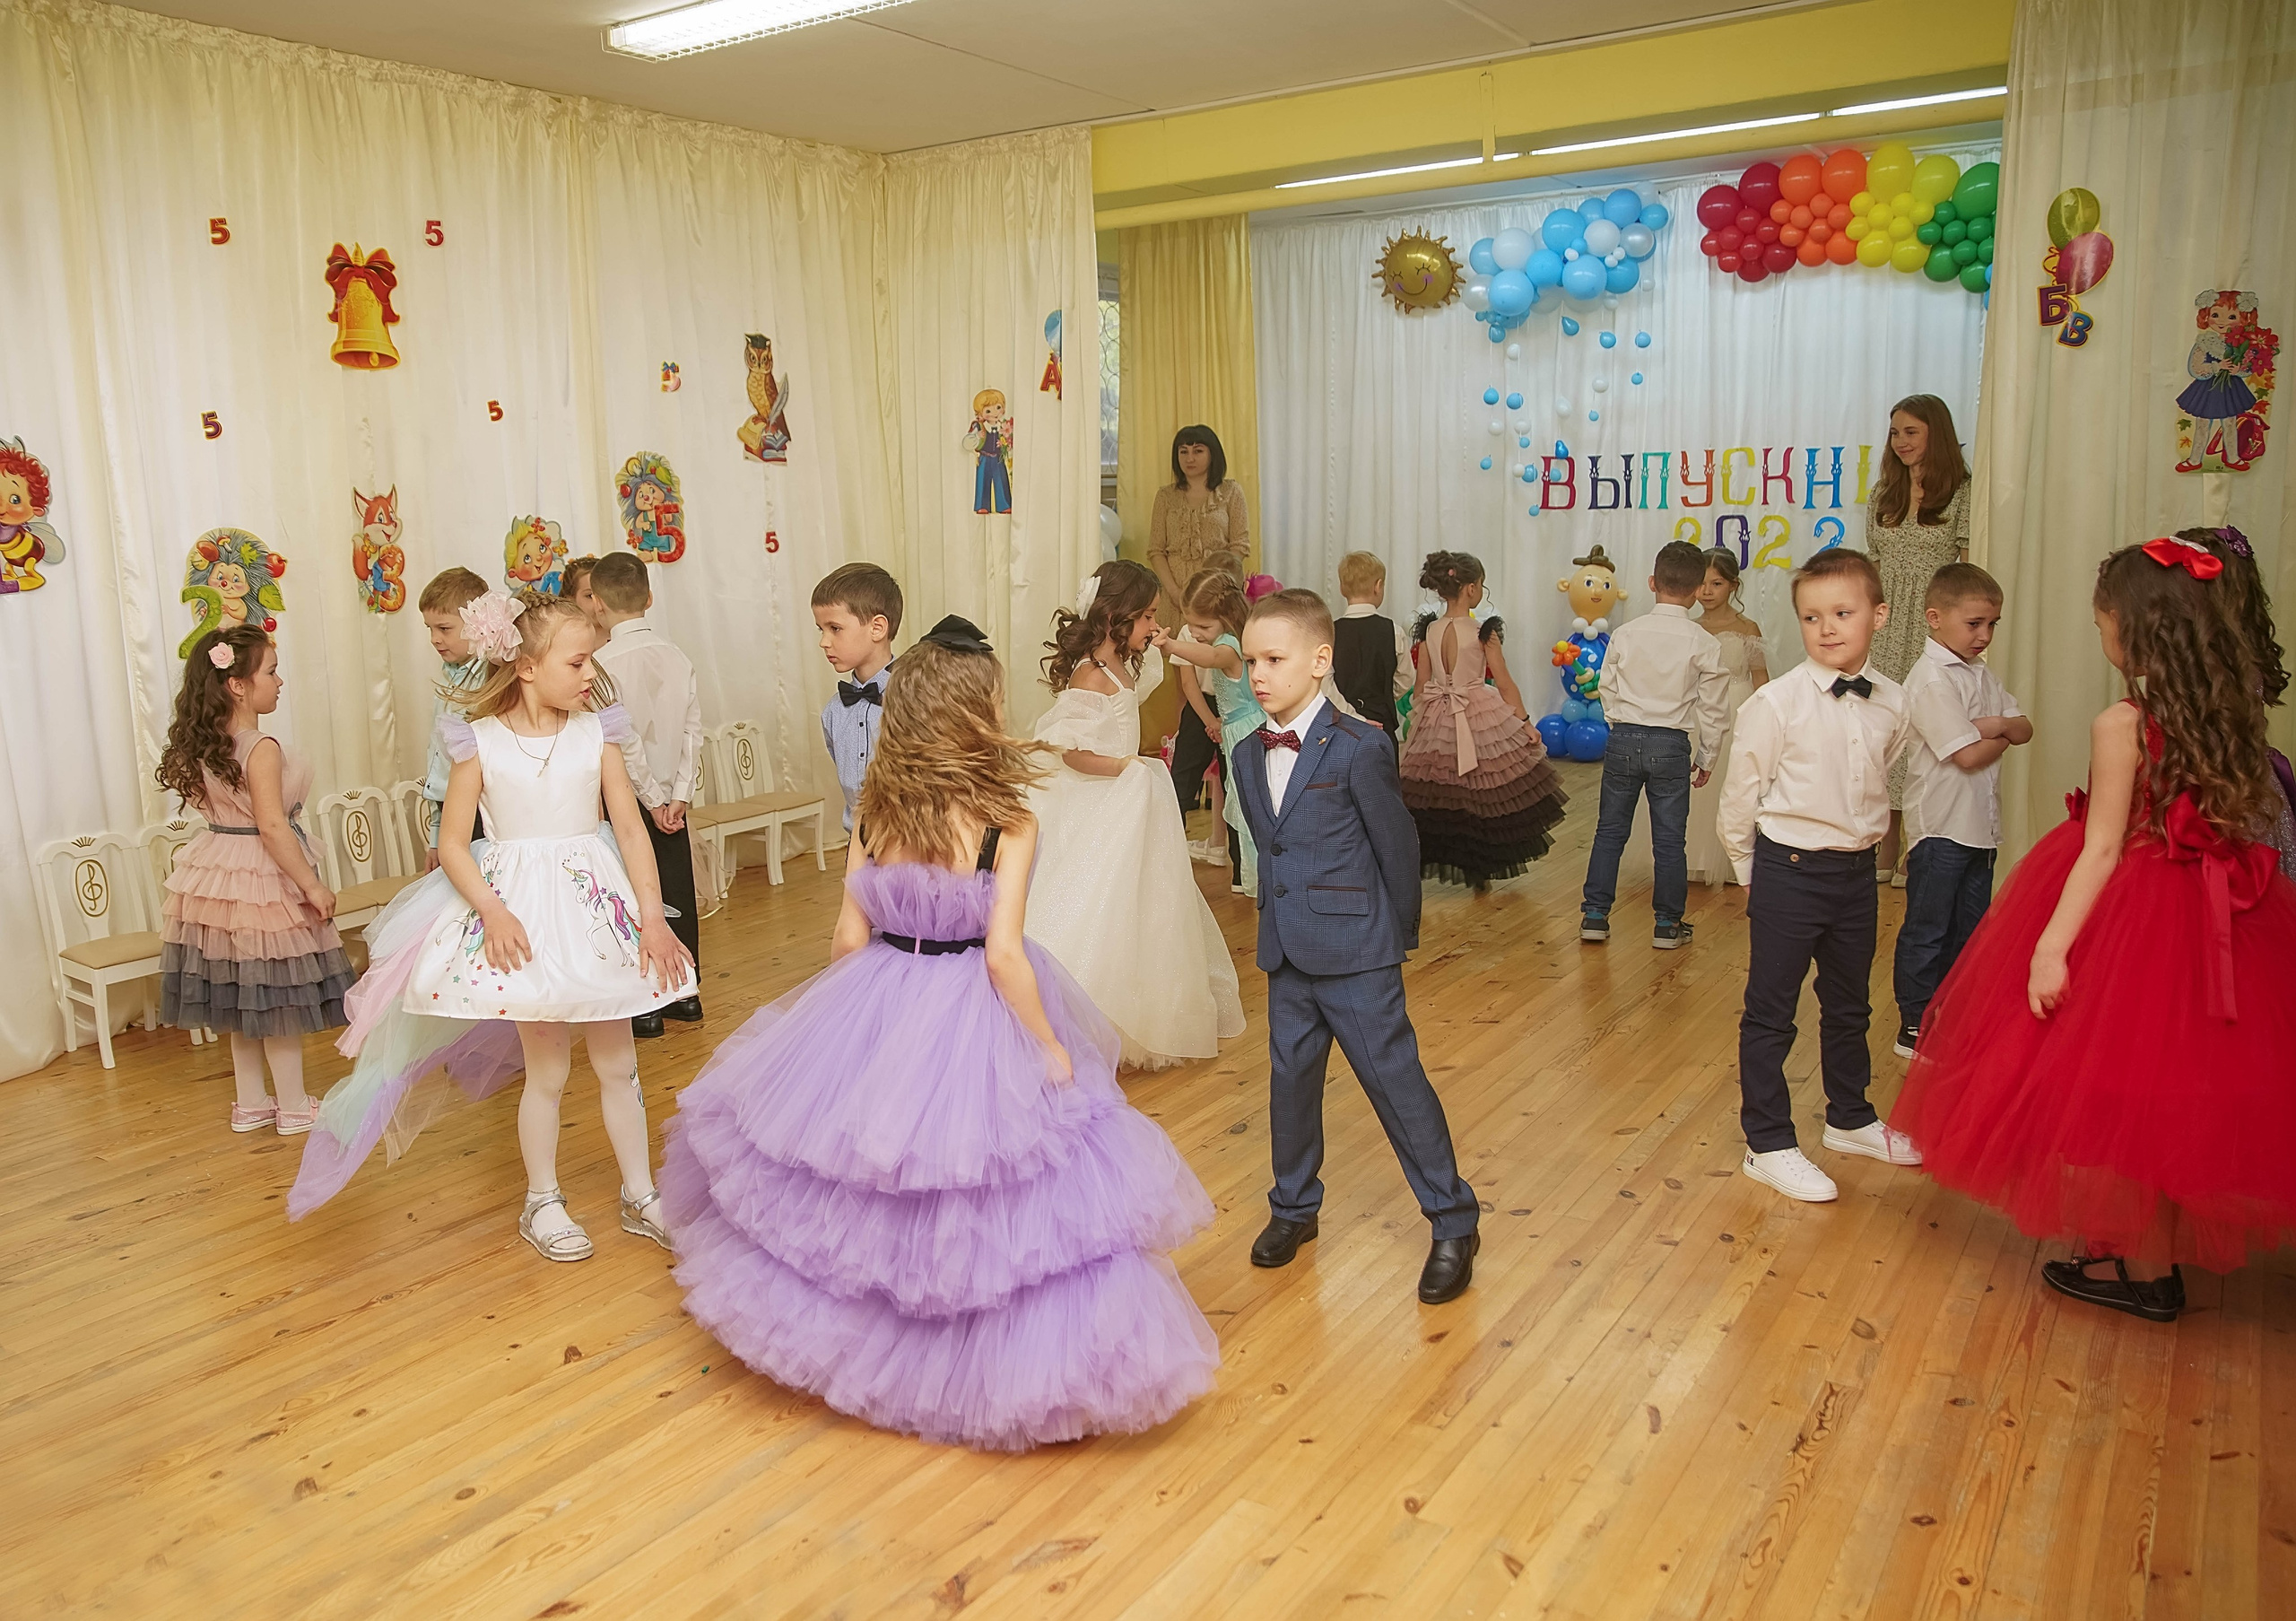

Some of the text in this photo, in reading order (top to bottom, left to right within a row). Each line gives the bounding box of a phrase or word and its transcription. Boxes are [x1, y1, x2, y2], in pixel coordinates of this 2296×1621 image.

[210, 218, 230, 244] 5
[425, 221, 443, 245] 5
[488, 401, 503, 421] 5
[202, 412, 222, 439] 5
[1539, 444, 1967, 510] ВЫПУСКН
[654, 503, 685, 562] 5
[765, 531, 779, 553] 5
[378, 544, 405, 612] 3
[178, 586, 222, 659] 2
